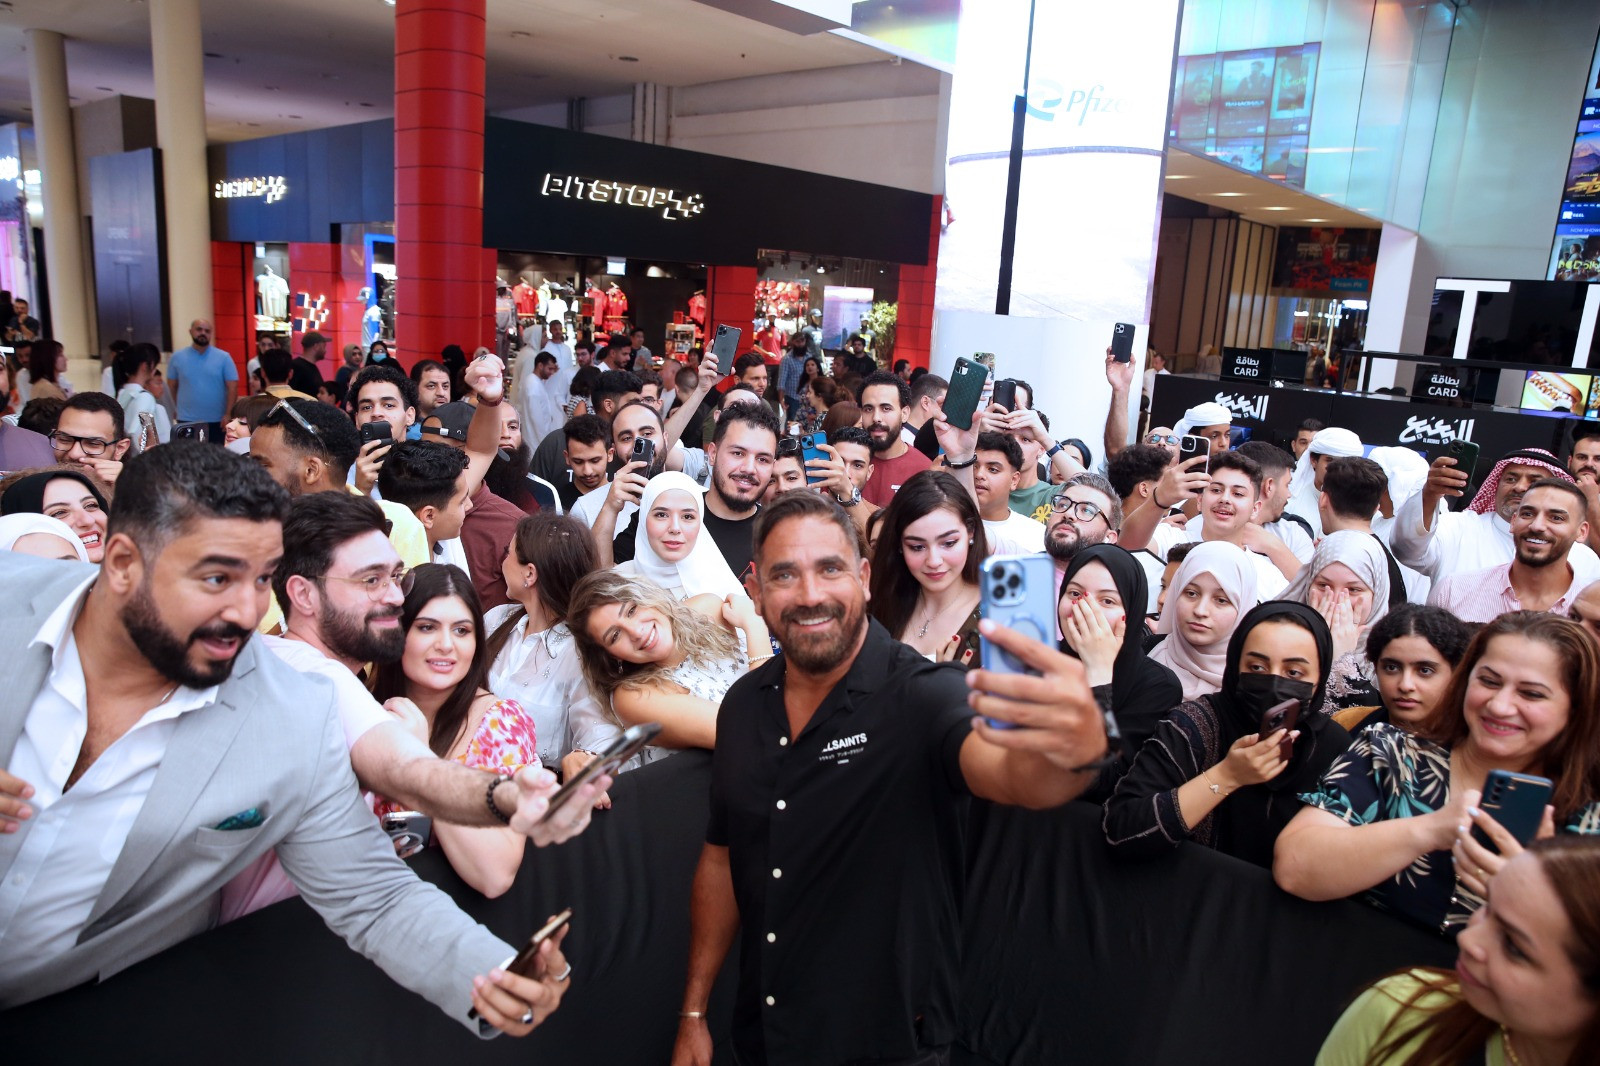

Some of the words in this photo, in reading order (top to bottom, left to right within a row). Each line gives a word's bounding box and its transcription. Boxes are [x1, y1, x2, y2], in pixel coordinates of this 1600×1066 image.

[1065, 84, 1134, 126] Pfize
[541, 173, 667, 208] PITSTOP
[1235, 356, 1259, 368] بطاقة
[1233, 366, 1259, 377] CARD
[1431, 374, 1460, 388] بطاقة
[1428, 386, 1459, 398] CARD
